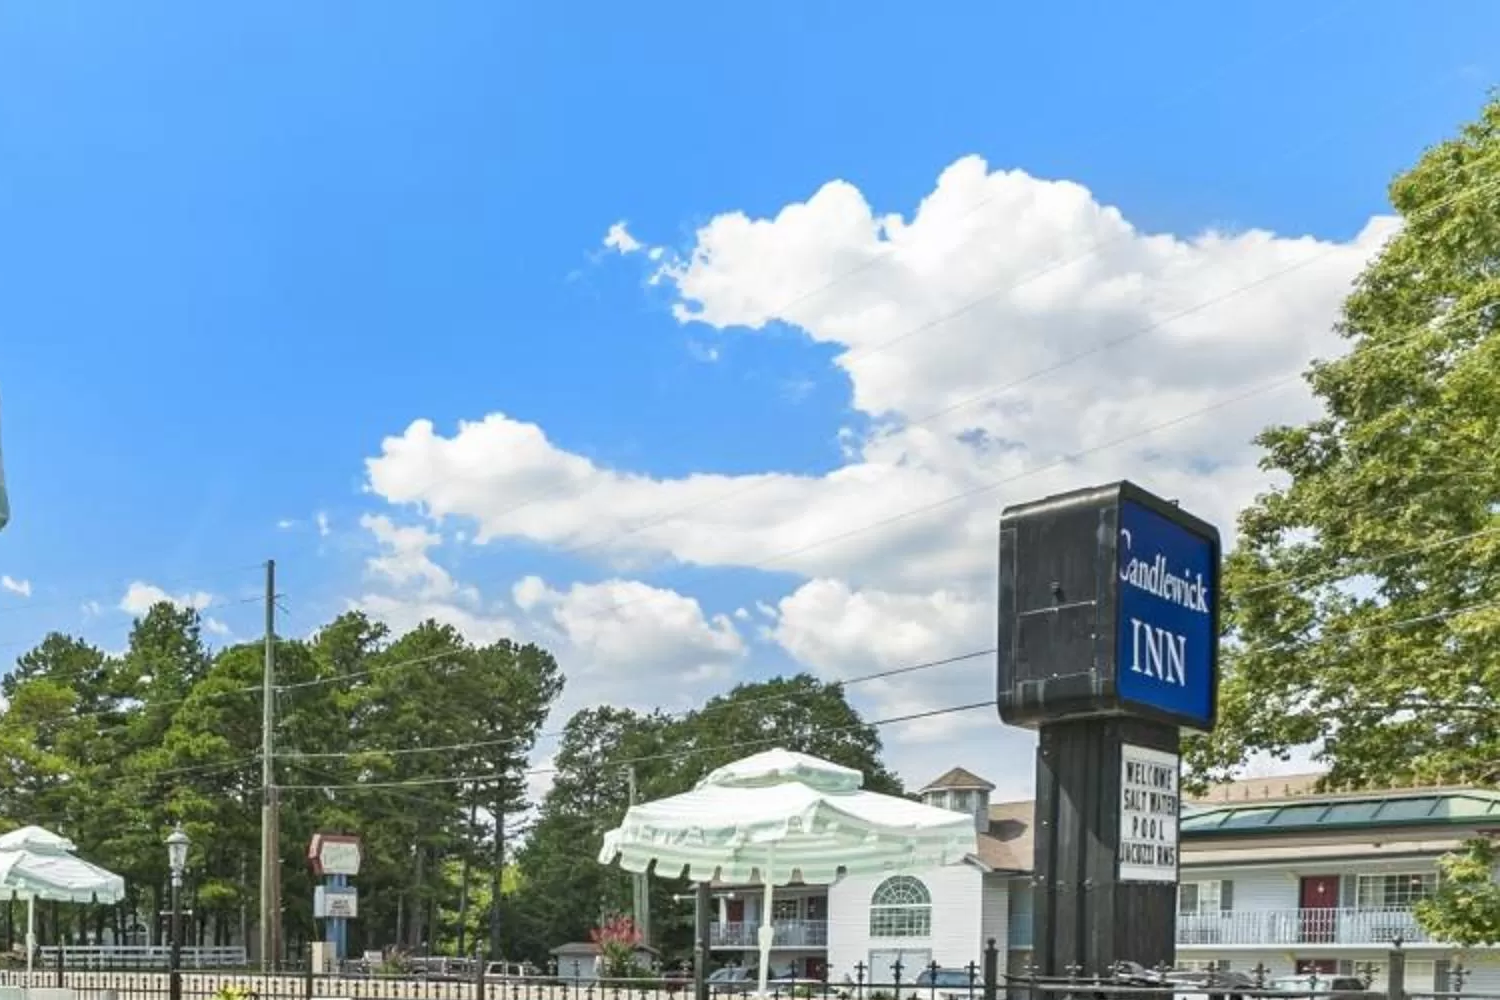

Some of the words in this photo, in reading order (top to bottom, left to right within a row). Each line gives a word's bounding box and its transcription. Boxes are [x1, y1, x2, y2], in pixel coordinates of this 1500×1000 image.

[1119, 528, 1210, 613] Candlewick
[1130, 617, 1187, 688] INN
[1126, 761, 1173, 791] WELCOME
[1124, 787, 1148, 812] SALT
[1131, 815, 1165, 841] POOL
